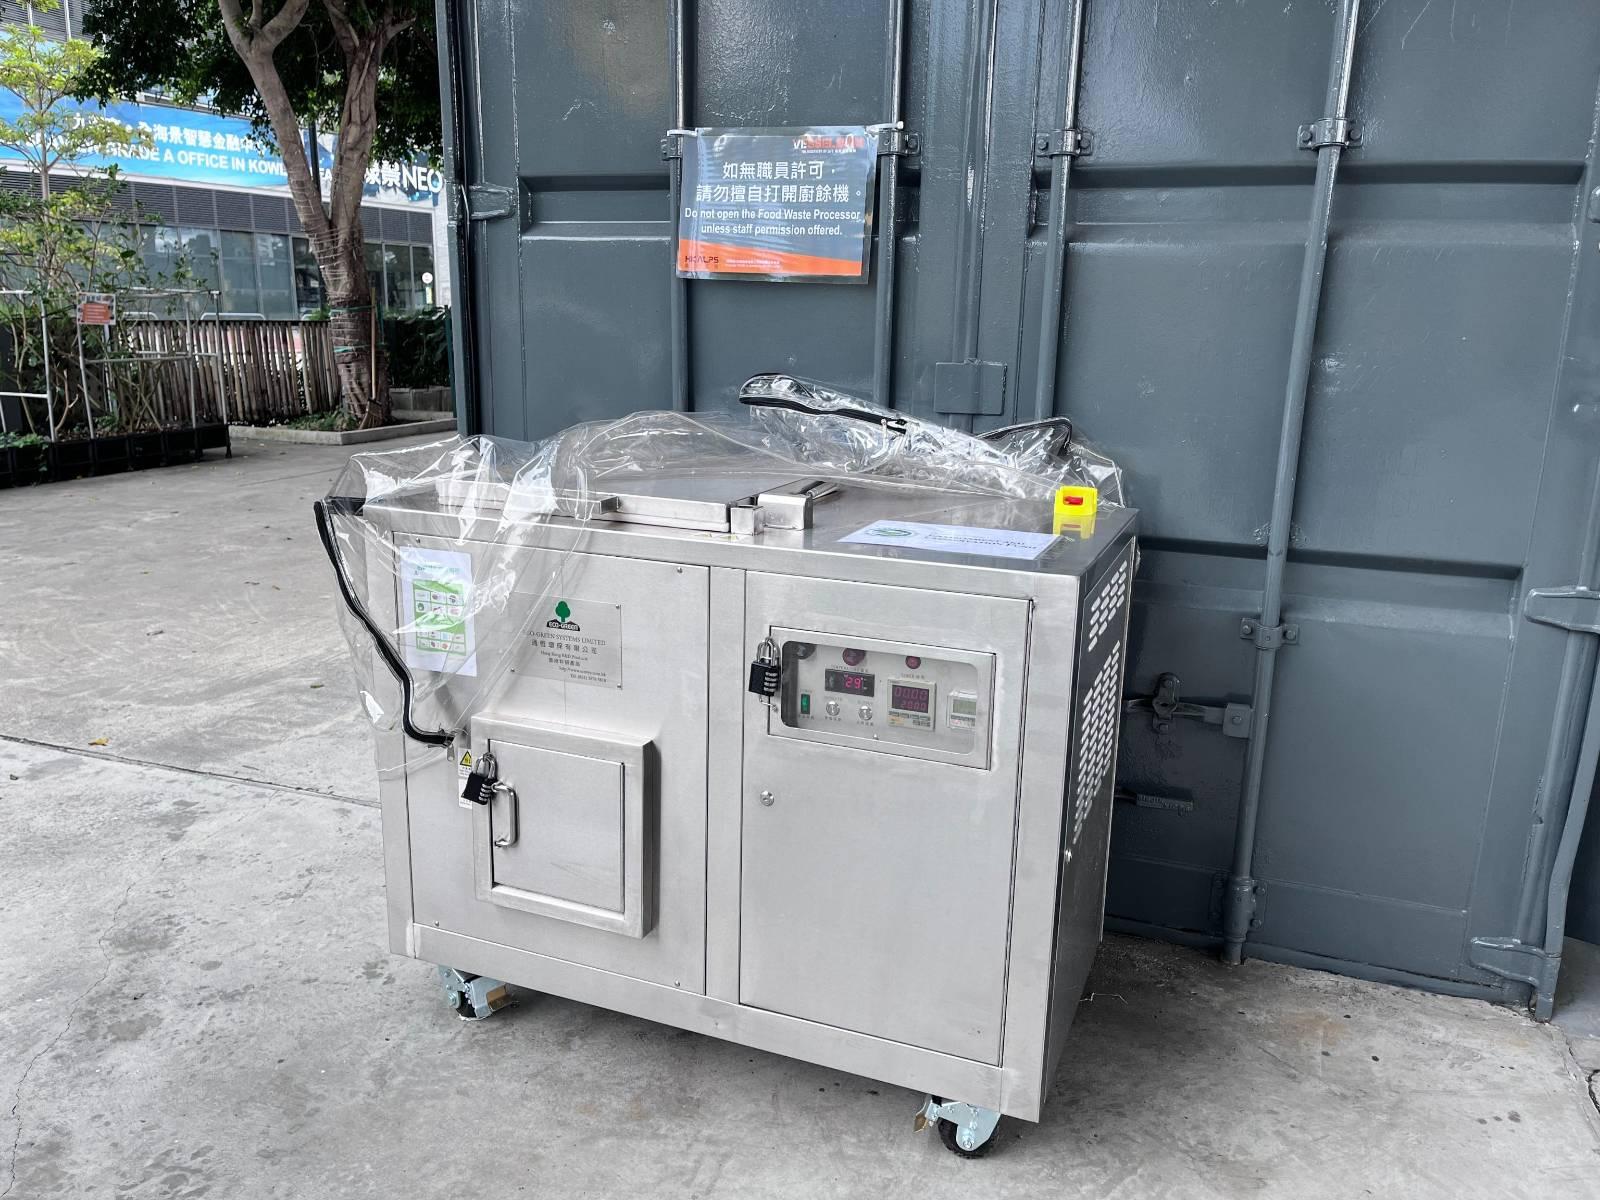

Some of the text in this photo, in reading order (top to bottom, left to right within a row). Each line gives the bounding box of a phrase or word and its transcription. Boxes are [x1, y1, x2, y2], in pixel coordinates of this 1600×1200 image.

[163, 148, 175, 163] A
[177, 149, 229, 169] OFFICE
[231, 156, 246, 172] IN
[696, 184, 861, 203] 請勿擅自打開廚餘機。
[684, 207, 698, 218] Do
[700, 208, 715, 218] not
[716, 209, 739, 221] open
[741, 209, 756, 219] the
[758, 209, 782, 219] Food
[784, 209, 812, 220] Waste
[701, 224, 843, 236] unless staff permission offered.
[581, 637, 606, 646] LIMITED
[845, 676, 862, 689] 29
